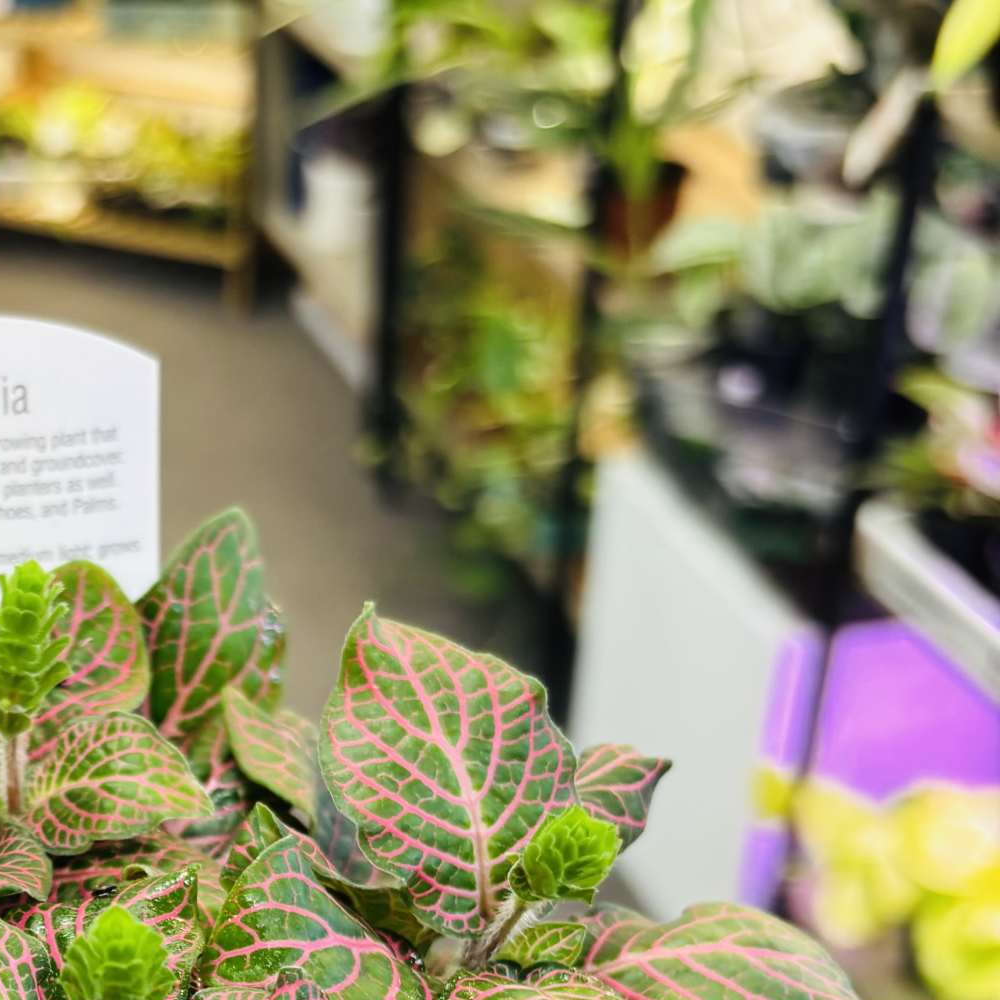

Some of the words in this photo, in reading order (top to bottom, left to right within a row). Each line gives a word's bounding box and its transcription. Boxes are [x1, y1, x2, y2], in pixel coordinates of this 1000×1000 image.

[51, 429, 87, 451] plant
[91, 426, 117, 444] that
[0, 457, 27, 475] and
[3, 479, 62, 501] planters
[67, 478, 83, 493] as
[40, 500, 67, 518] and
